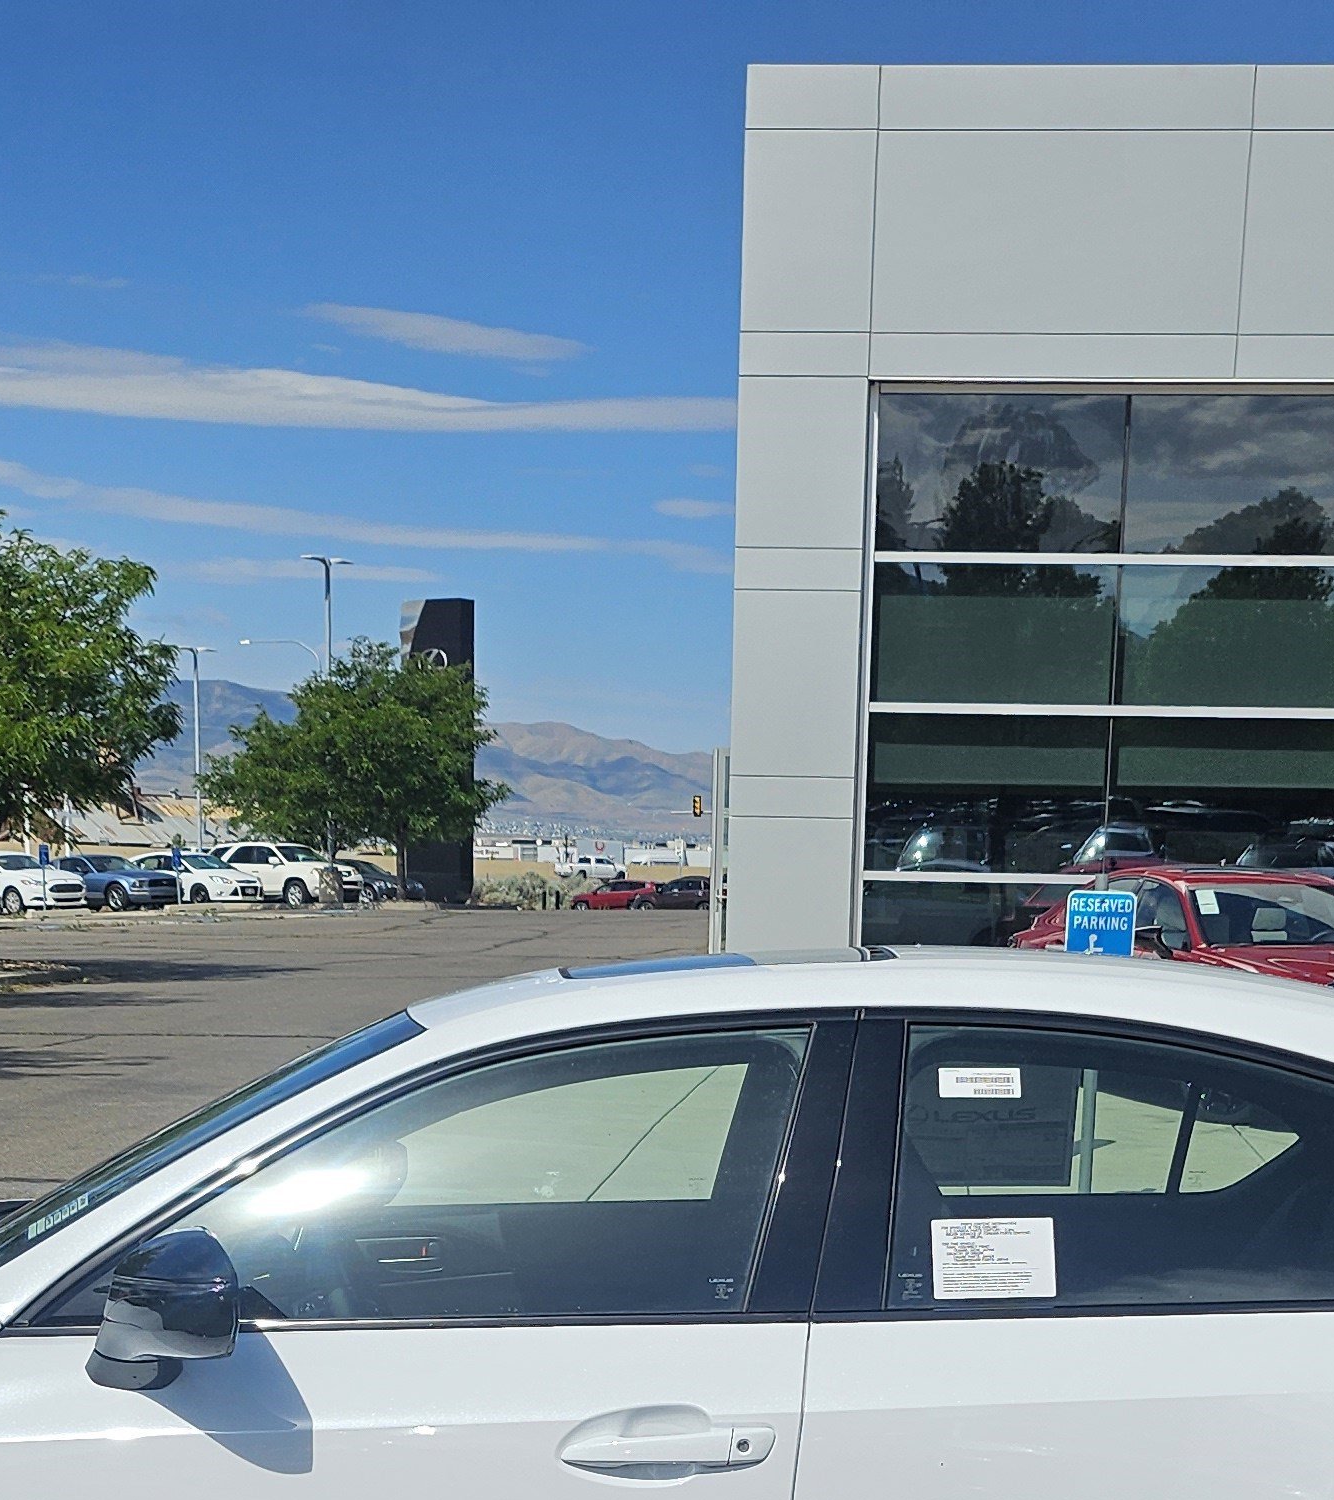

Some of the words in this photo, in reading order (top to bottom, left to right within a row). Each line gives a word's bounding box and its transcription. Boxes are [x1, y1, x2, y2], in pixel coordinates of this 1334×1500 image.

[1071, 897, 1133, 913] RESERVED
[1073, 915, 1128, 931] PARKING
[934, 1106, 1037, 1123] LEXUS
